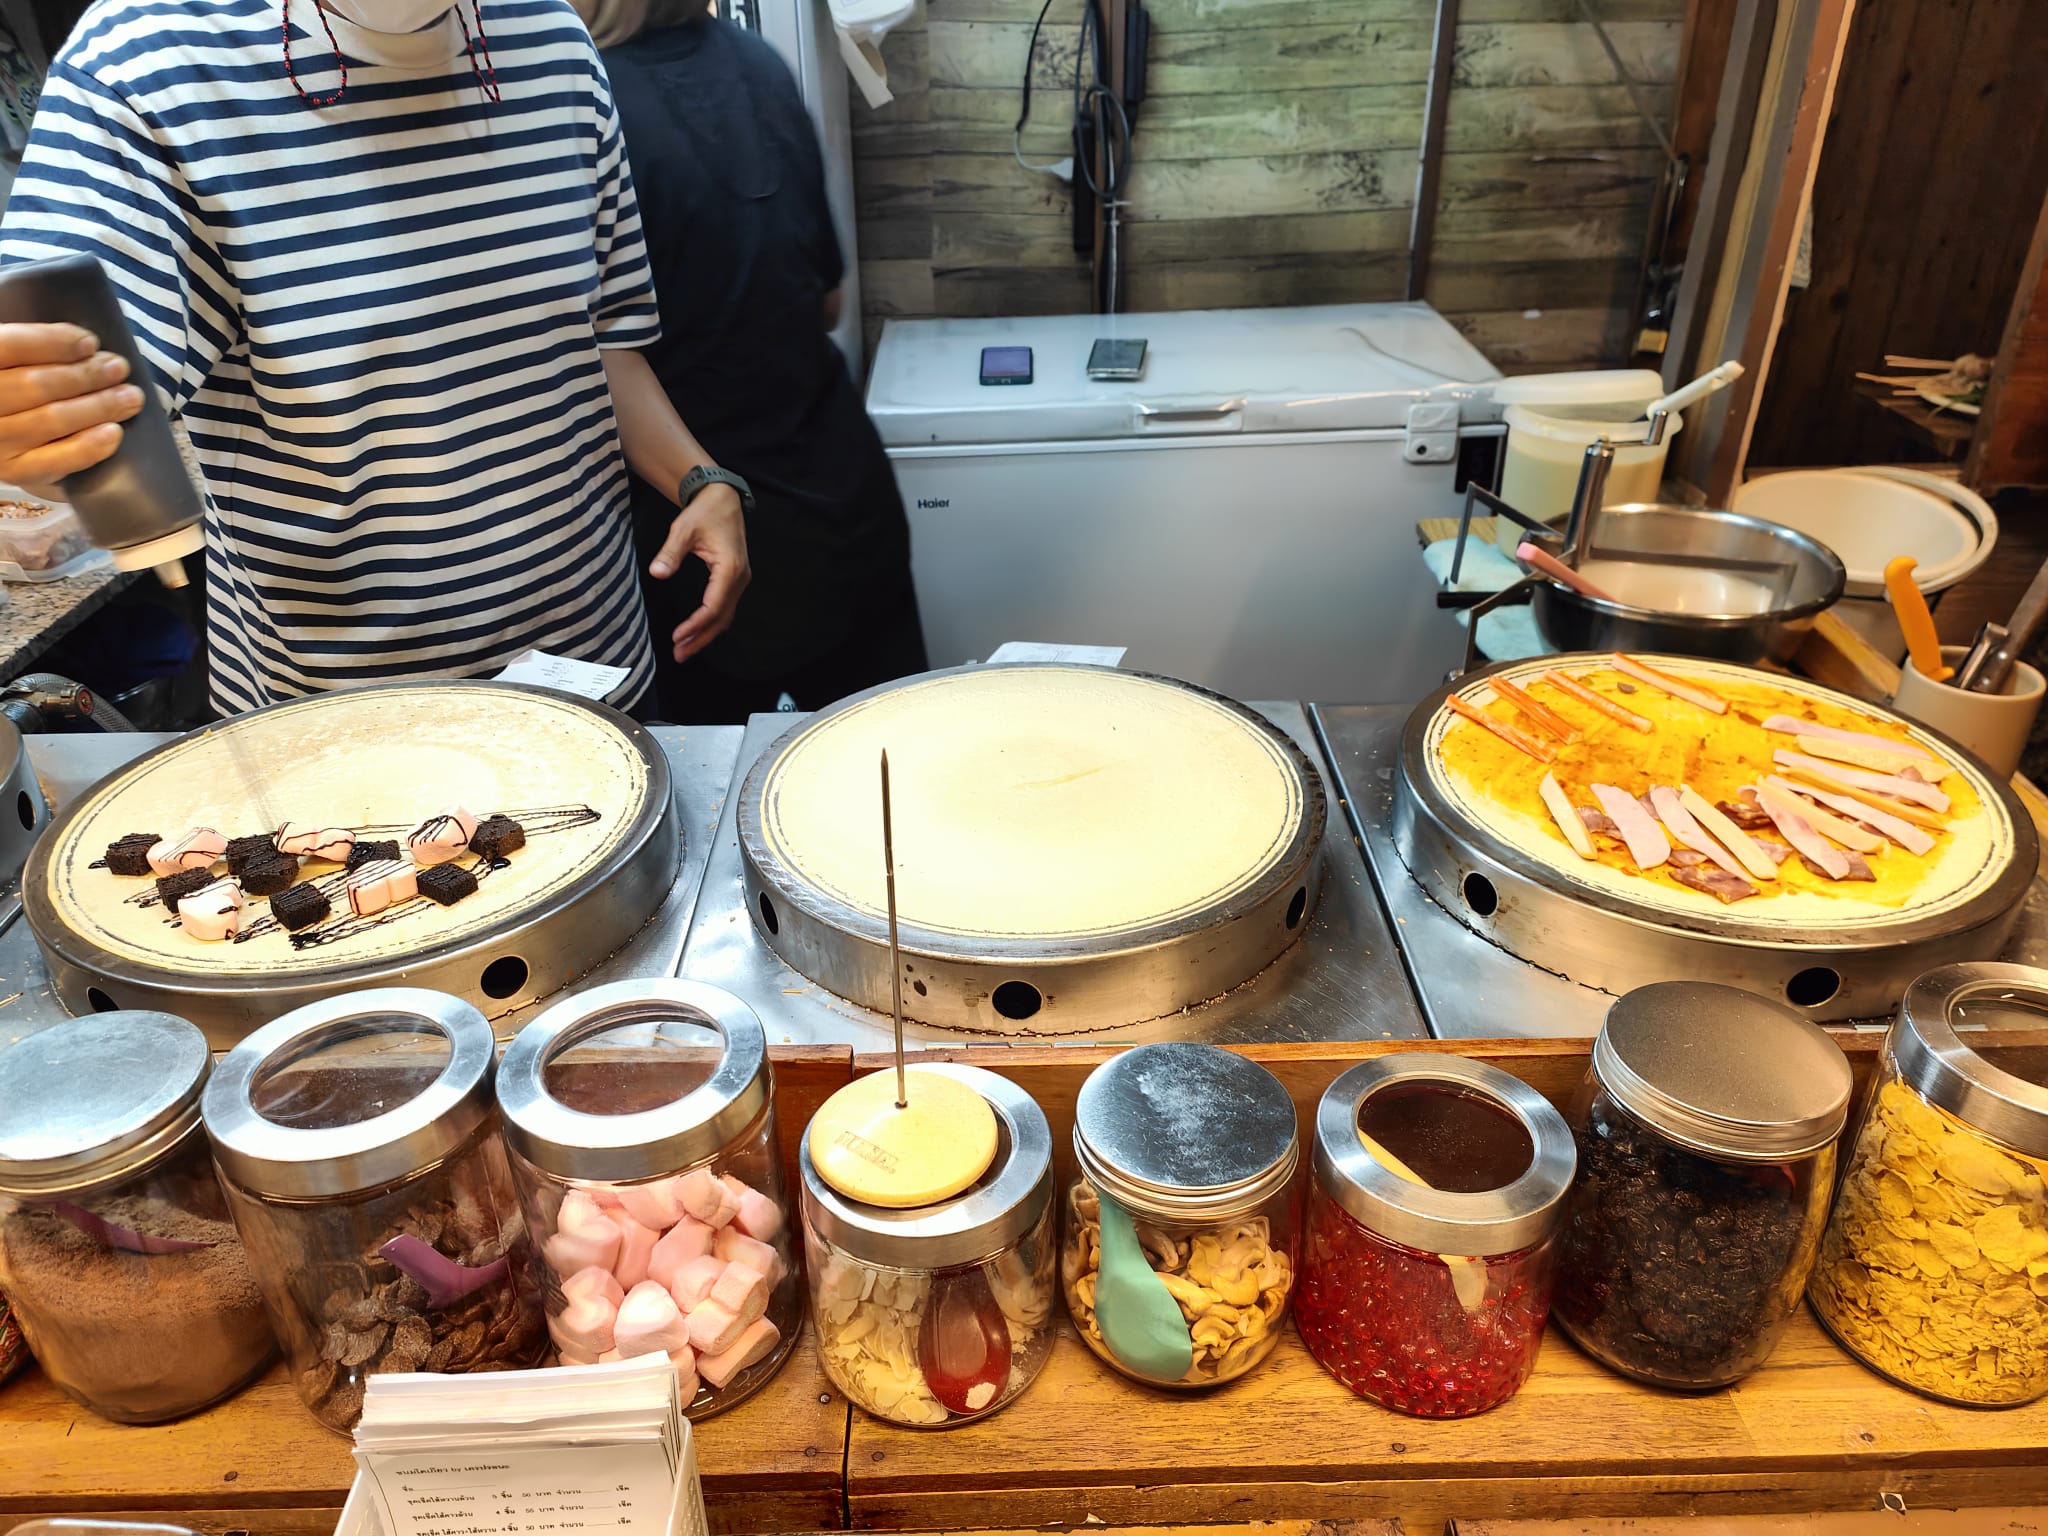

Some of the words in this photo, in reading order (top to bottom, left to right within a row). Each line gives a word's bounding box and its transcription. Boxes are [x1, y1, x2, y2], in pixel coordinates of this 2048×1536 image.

[917, 496, 950, 509] Haier
[500, 1490, 513, 1498] ชิ้น
[504, 1506, 516, 1515] ชิ้น
[507, 1522, 519, 1532] ชิ้น
[559, 1521, 584, 1529] จำนวน
